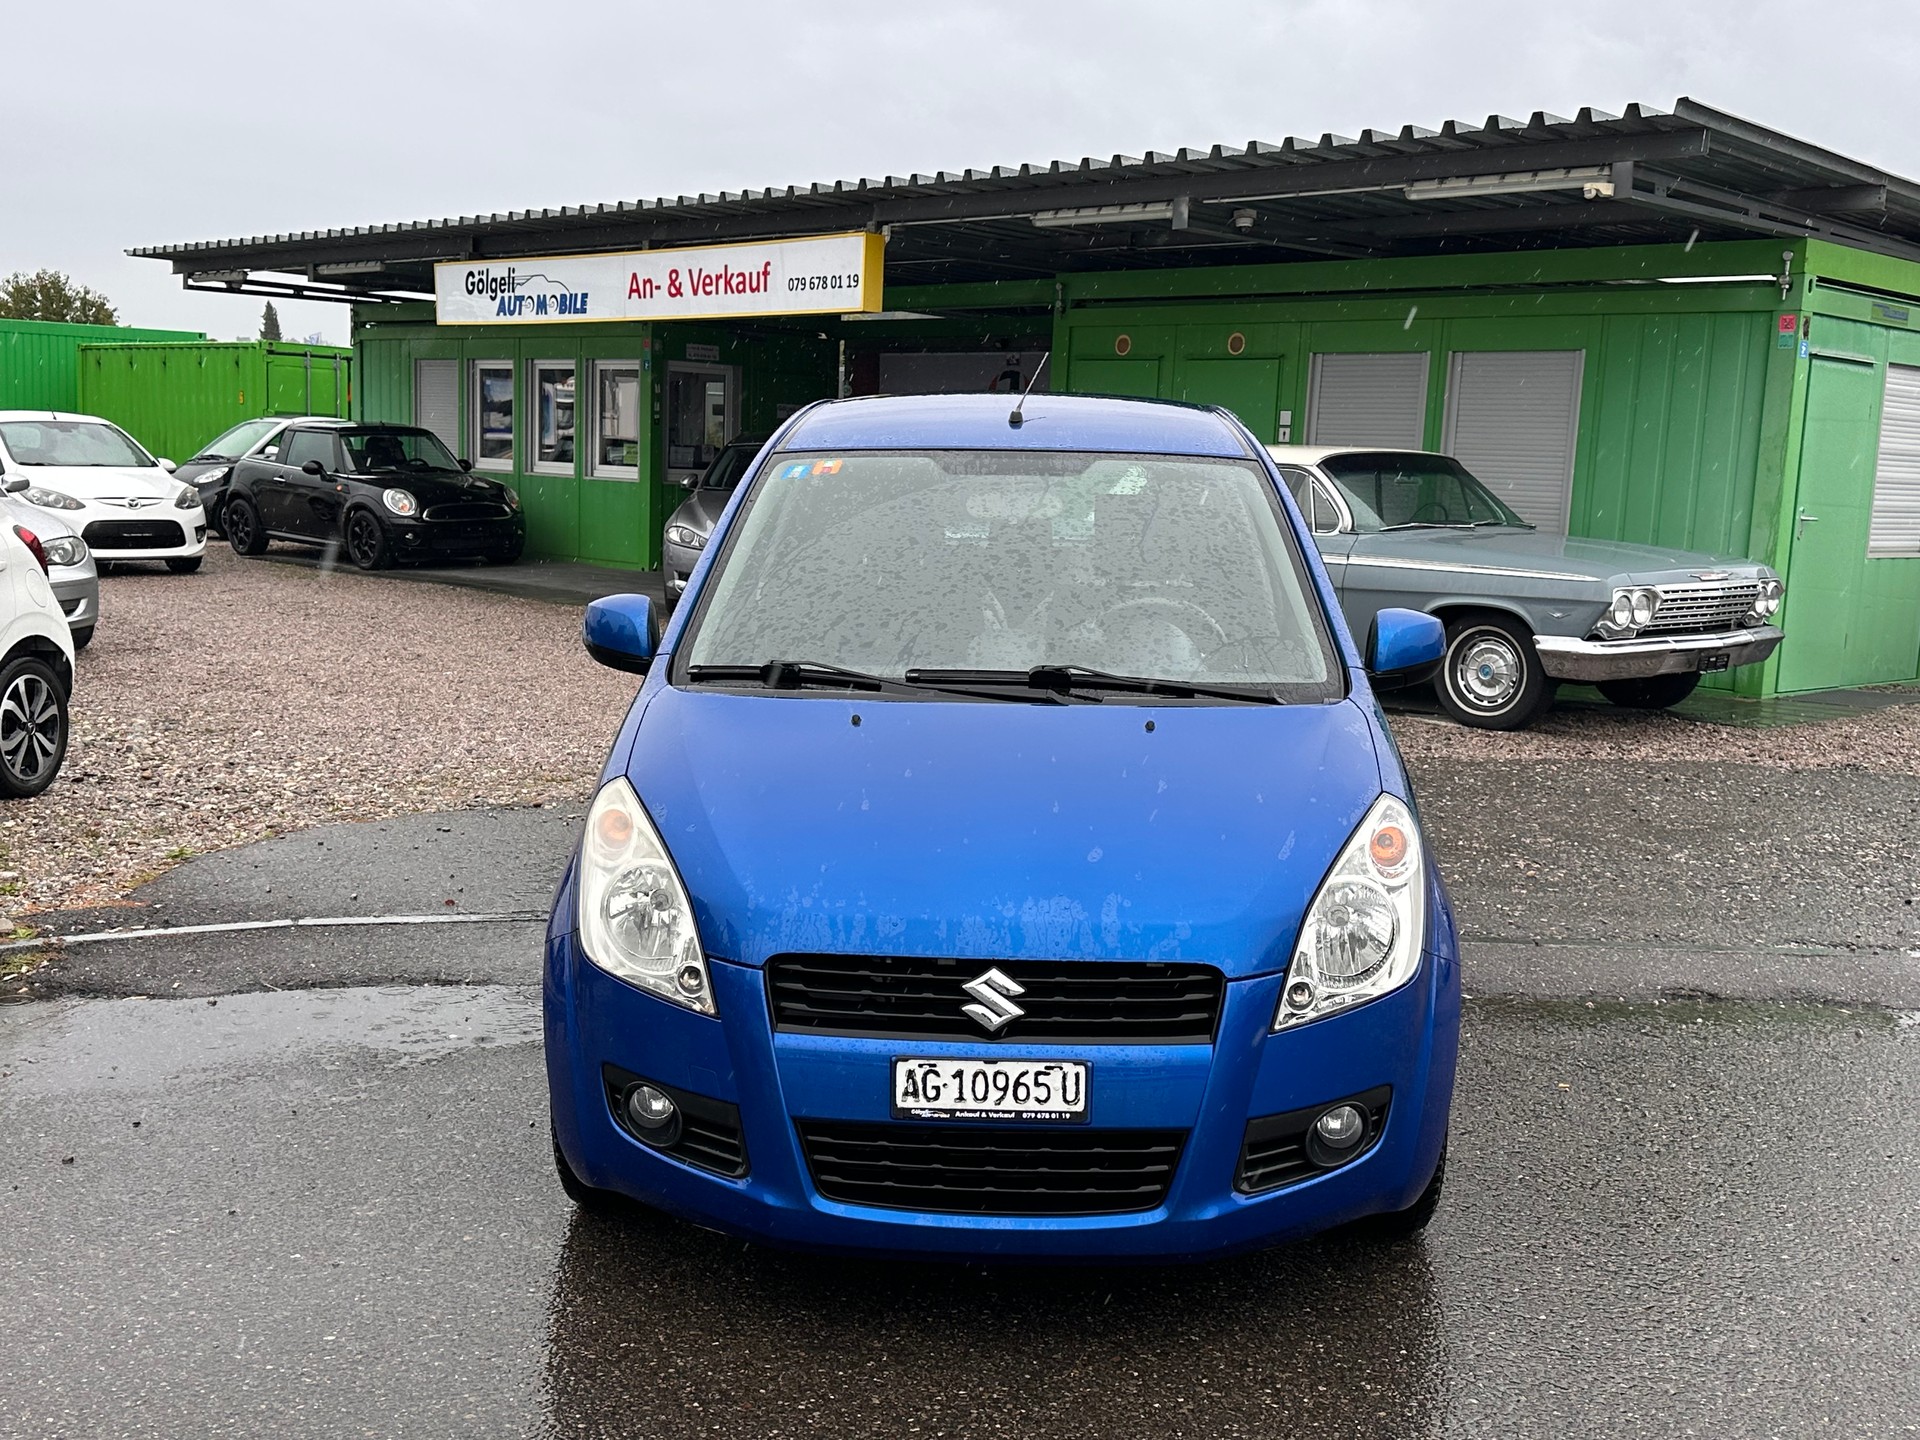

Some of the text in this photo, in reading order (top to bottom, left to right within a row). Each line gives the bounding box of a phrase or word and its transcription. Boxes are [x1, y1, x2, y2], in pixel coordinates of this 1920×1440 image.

[465, 267, 516, 301] Gölgeli
[628, 261, 771, 299] An- & Verkauf
[788, 274, 859, 291] 079 678 01 19
[496, 293, 588, 316] AUTOMOBILE
